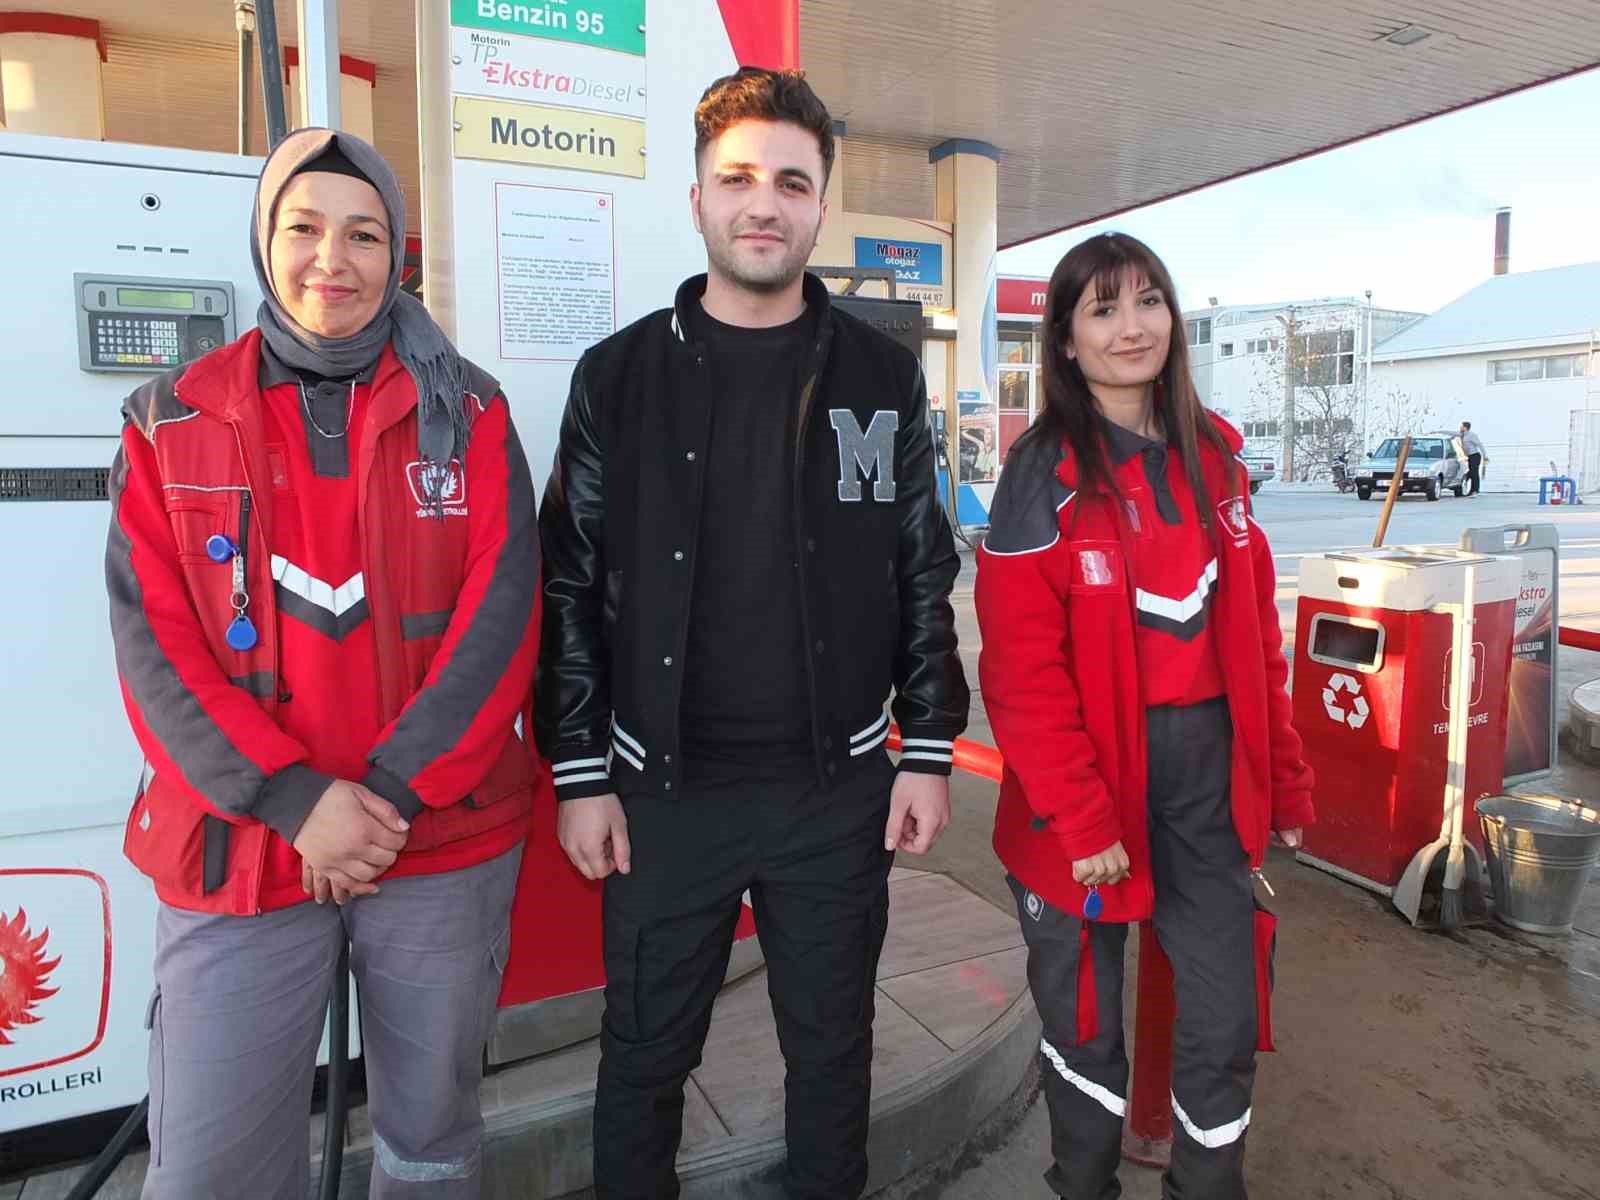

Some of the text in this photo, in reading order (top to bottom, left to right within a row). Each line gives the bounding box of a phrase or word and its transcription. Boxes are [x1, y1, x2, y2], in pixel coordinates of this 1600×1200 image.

[477, 0, 605, 35] Benzin 95
[470, 33, 511, 47] Motorin
[471, 43, 499, 64] TP
[490, 116, 617, 158] Motorin
[876, 242, 920, 259] Mogaz
[829, 409, 899, 502] M
[1467, 712, 1489, 728] EVRE
